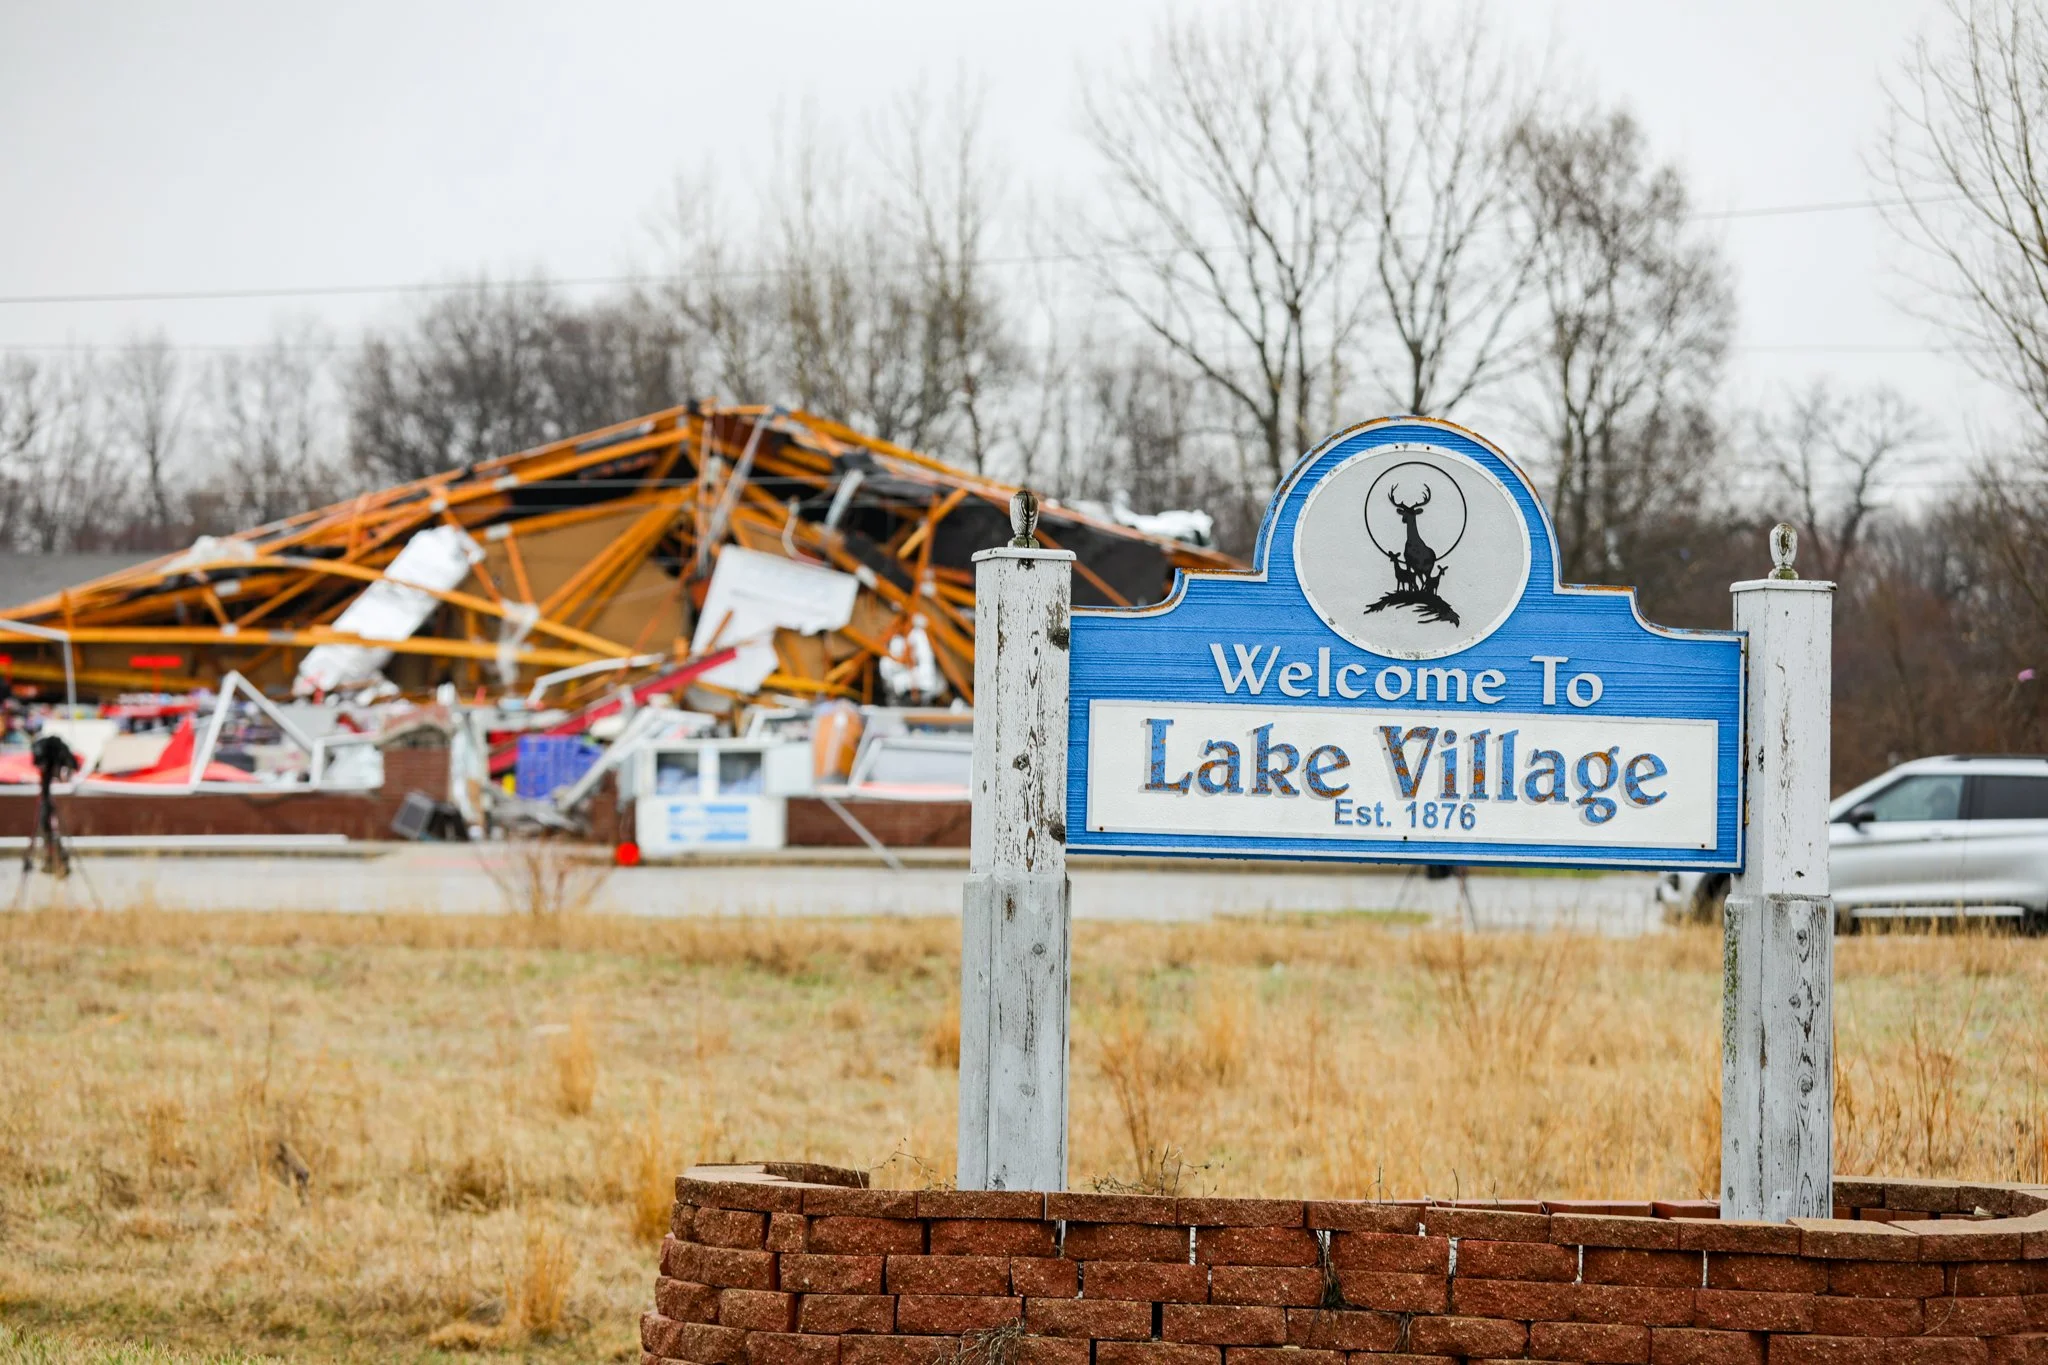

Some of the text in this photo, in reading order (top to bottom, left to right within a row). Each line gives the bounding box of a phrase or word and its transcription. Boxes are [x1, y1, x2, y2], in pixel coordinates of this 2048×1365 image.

[1209, 643, 1604, 708] Welcome To
[1141, 717, 1669, 825] Lake Village
[1333, 798, 1477, 831] Est. 1876
